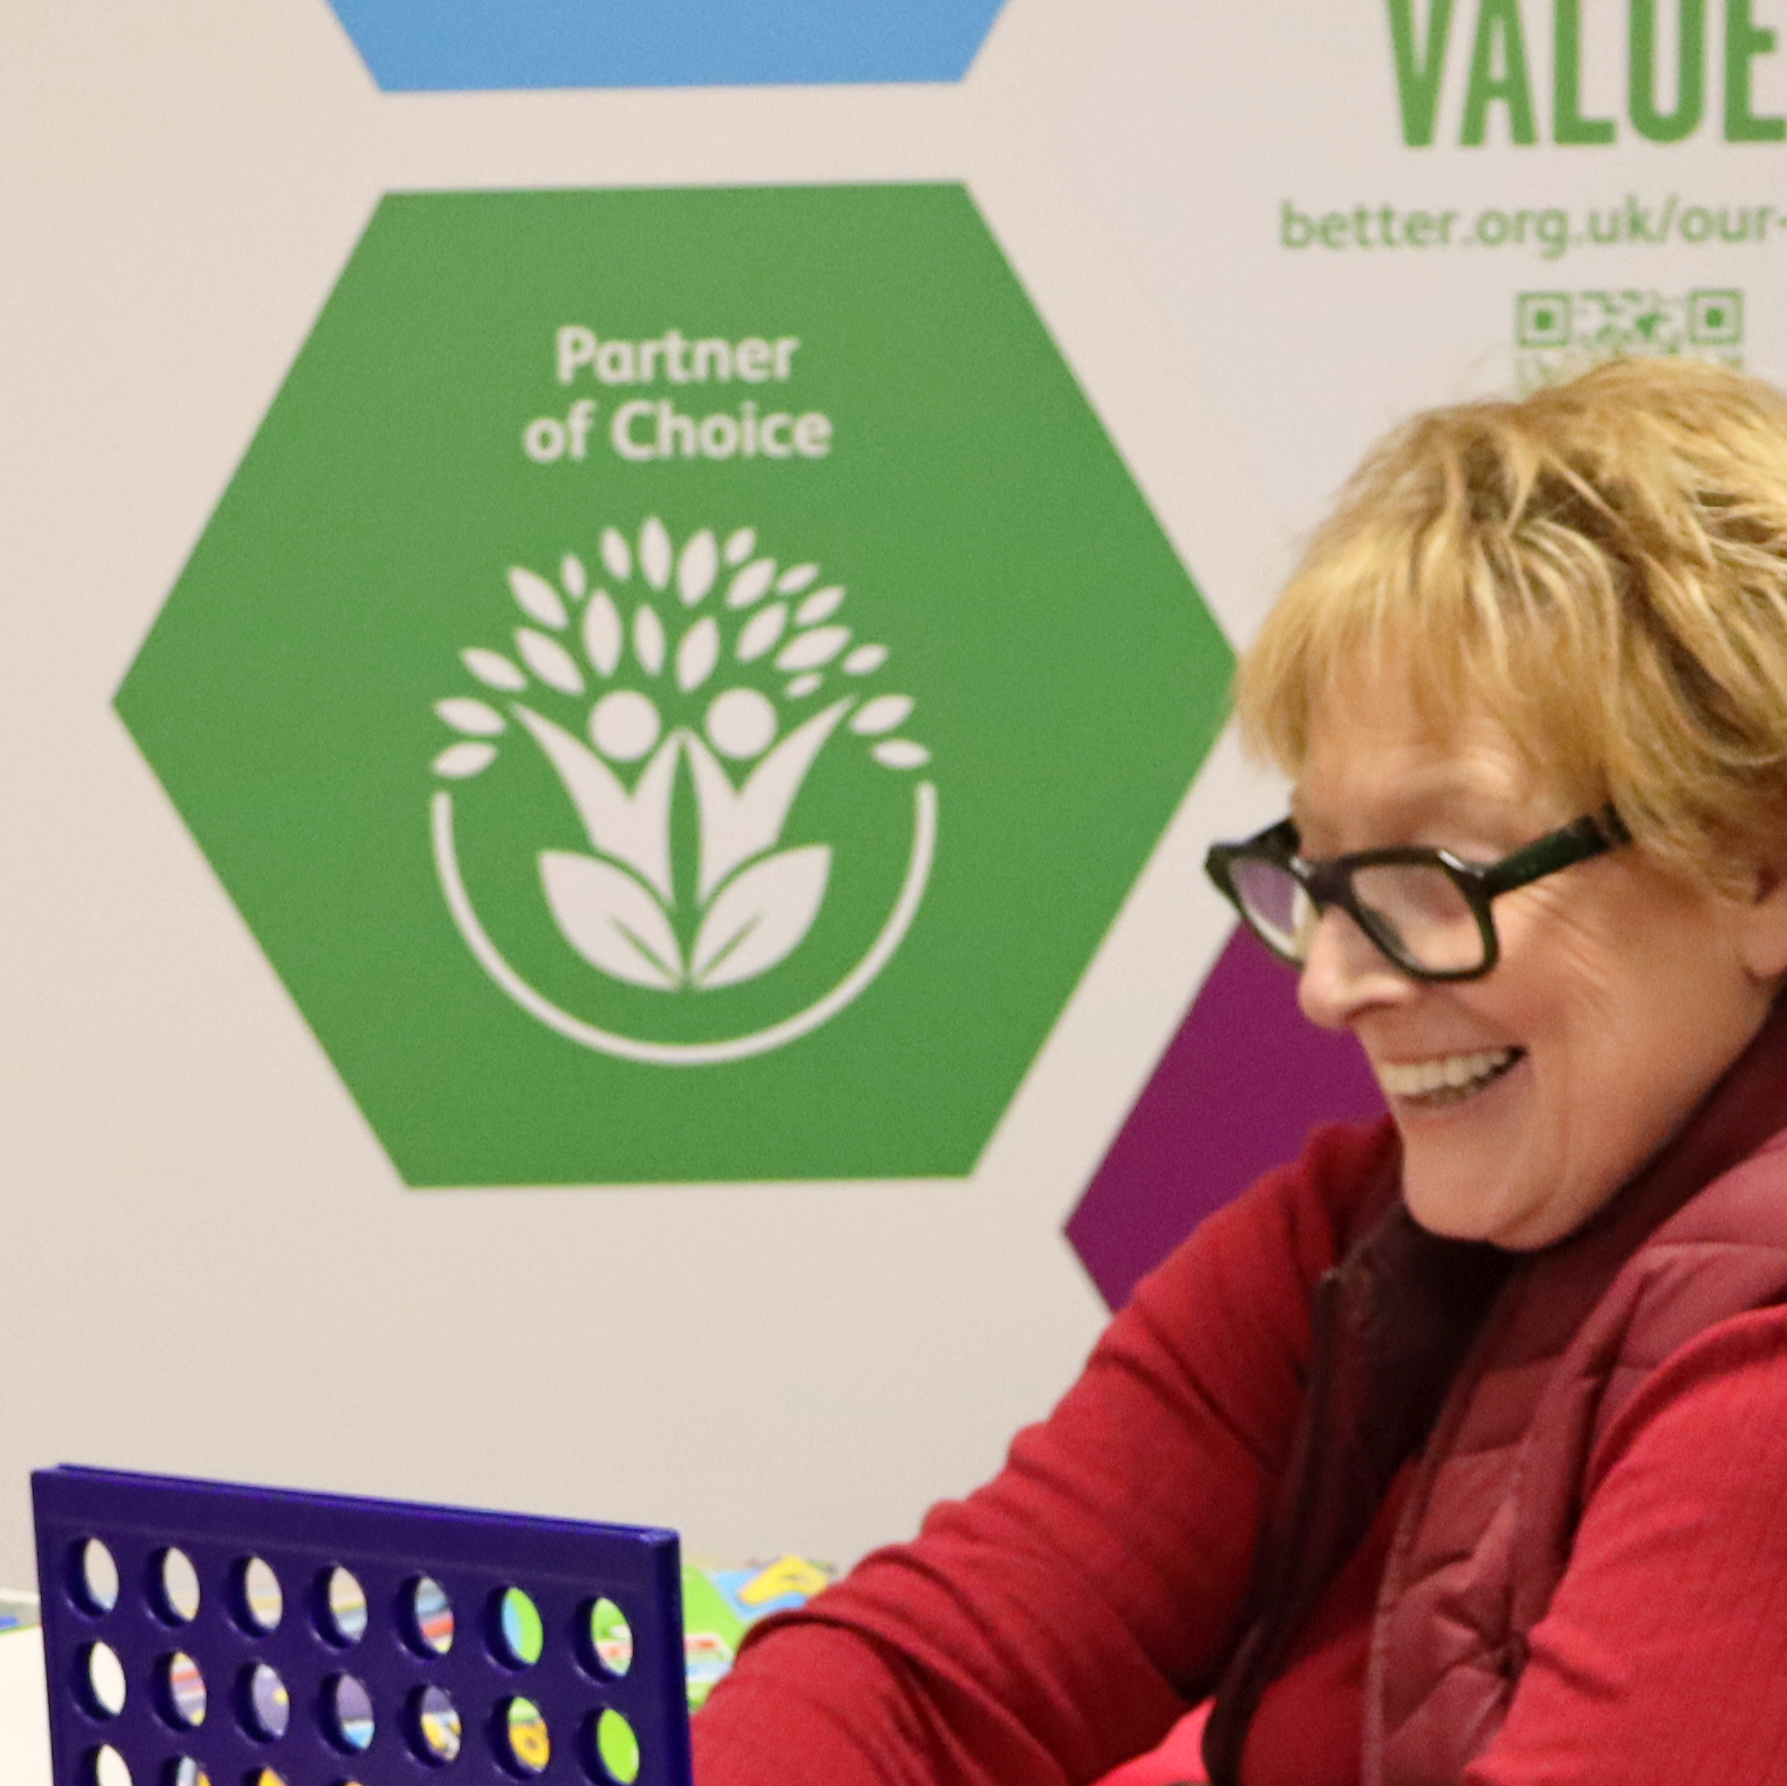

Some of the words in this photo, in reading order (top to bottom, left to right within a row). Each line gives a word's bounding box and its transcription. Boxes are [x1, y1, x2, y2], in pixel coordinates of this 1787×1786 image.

[555, 324, 800, 385] Partner
[523, 399, 597, 462] of
[610, 399, 833, 461] Choice
